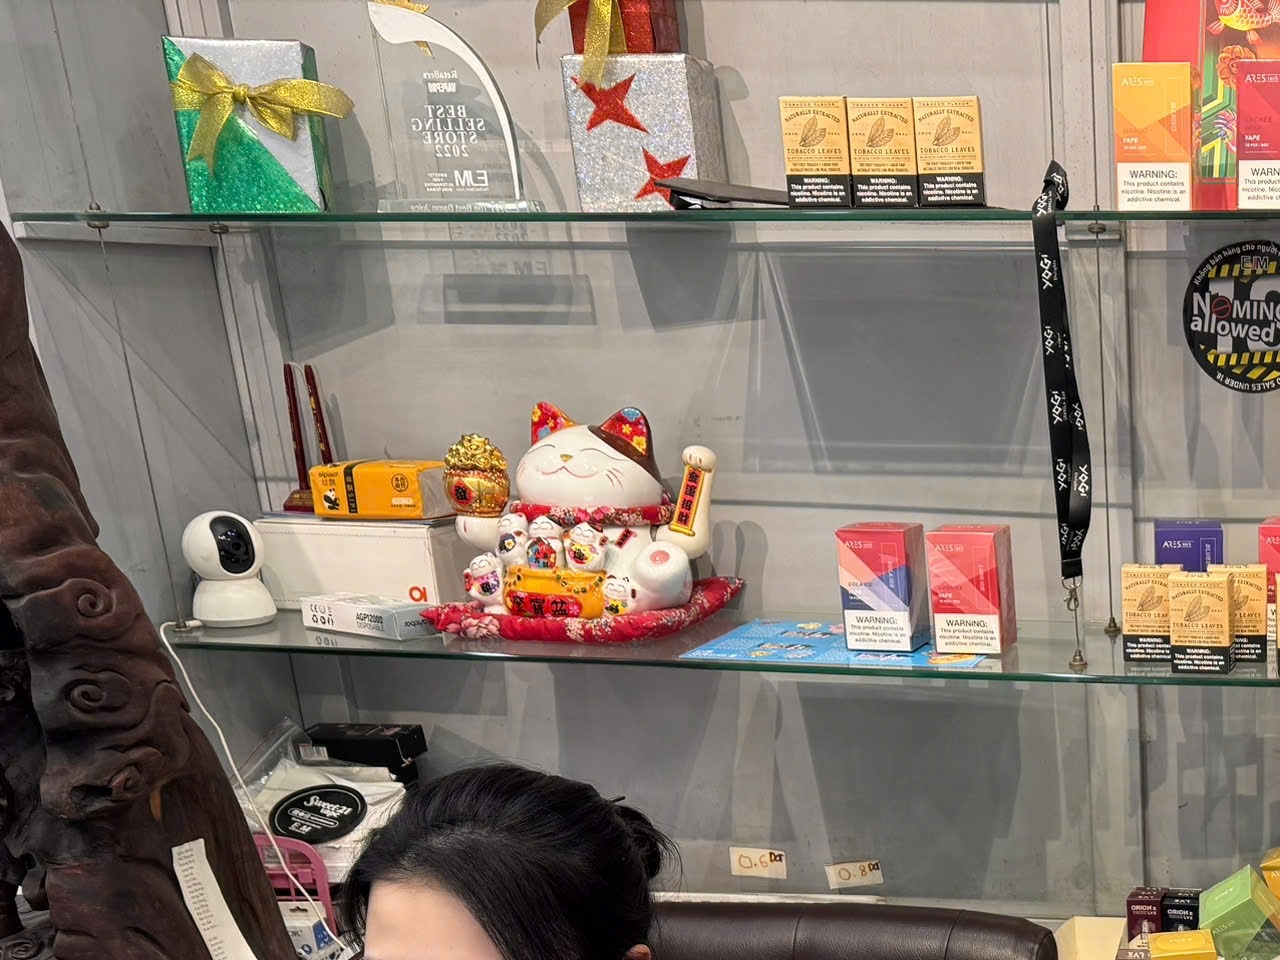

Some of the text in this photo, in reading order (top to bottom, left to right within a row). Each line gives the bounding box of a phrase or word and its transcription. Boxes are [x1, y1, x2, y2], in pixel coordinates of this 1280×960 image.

[1246, 74, 1266, 82] ARES
[1130, 170, 1177, 179] WARNING:
[1040, 255, 1052, 290] YOGI
[1190, 312, 1277, 342] allowed
[1051, 391, 1063, 424] YOGI
[1056, 459, 1067, 491] YOGI
[1079, 464, 1089, 497] YOGI
[946, 620, 987, 628] WARNING:
